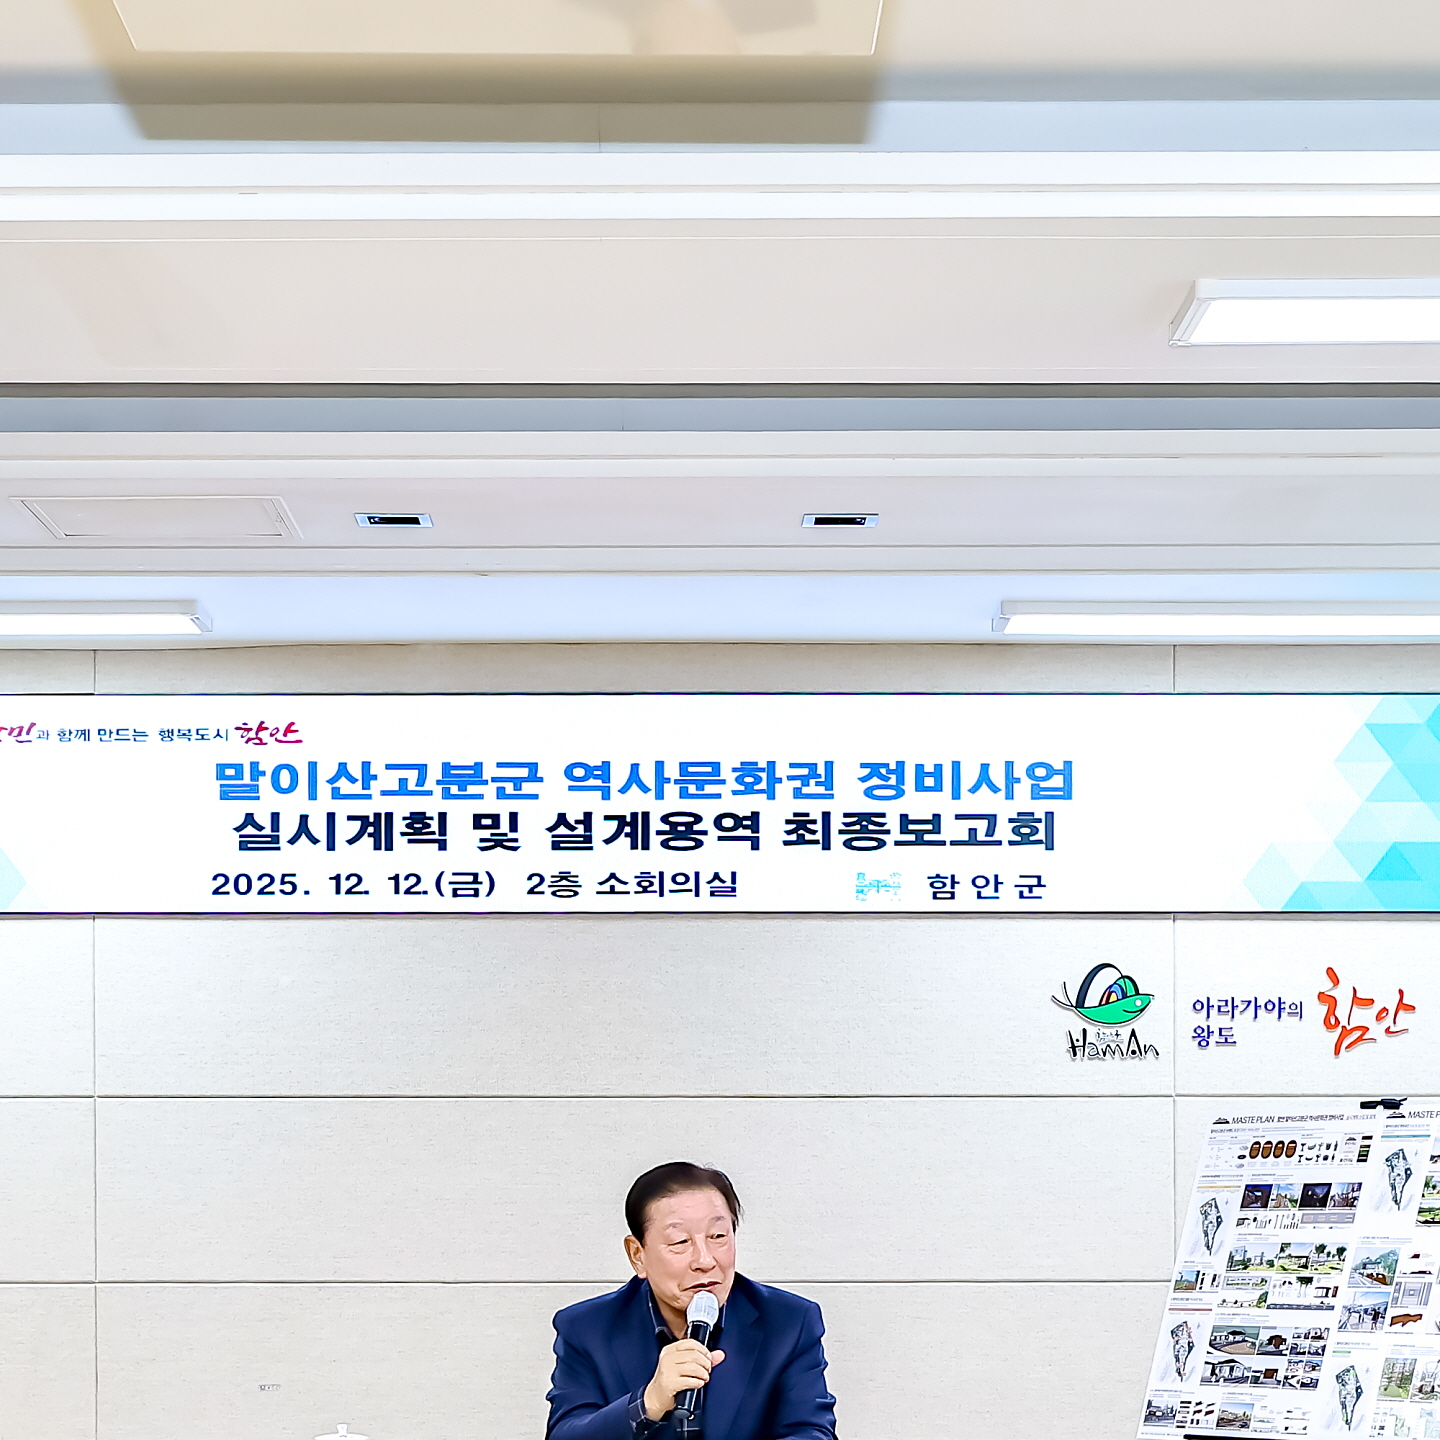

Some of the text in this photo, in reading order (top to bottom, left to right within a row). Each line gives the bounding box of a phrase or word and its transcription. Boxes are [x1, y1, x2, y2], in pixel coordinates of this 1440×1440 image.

[57, 728, 91, 742] 함께
[97, 728, 149, 742] 만드는
[158, 728, 229, 742] 행복도시
[234, 720, 303, 745] 함안
[215, 760, 1073, 801] 말이산고분군 역사문화권 정비사업
[233, 811, 1055, 851] 실시계획 및 설계용역 최종보고회
[211, 872, 310, 896] 2025.
[329, 872, 370, 896] 12.
[526, 870, 582, 898] 2층
[596, 870, 738, 898] 소회의실
[1191, 996, 1303, 1021] 아라가야의
[1317, 966, 1416, 1057] 함안
[1068, 1027, 1160, 1058] HamAn
[1191, 1025, 1237, 1047] 왕도
